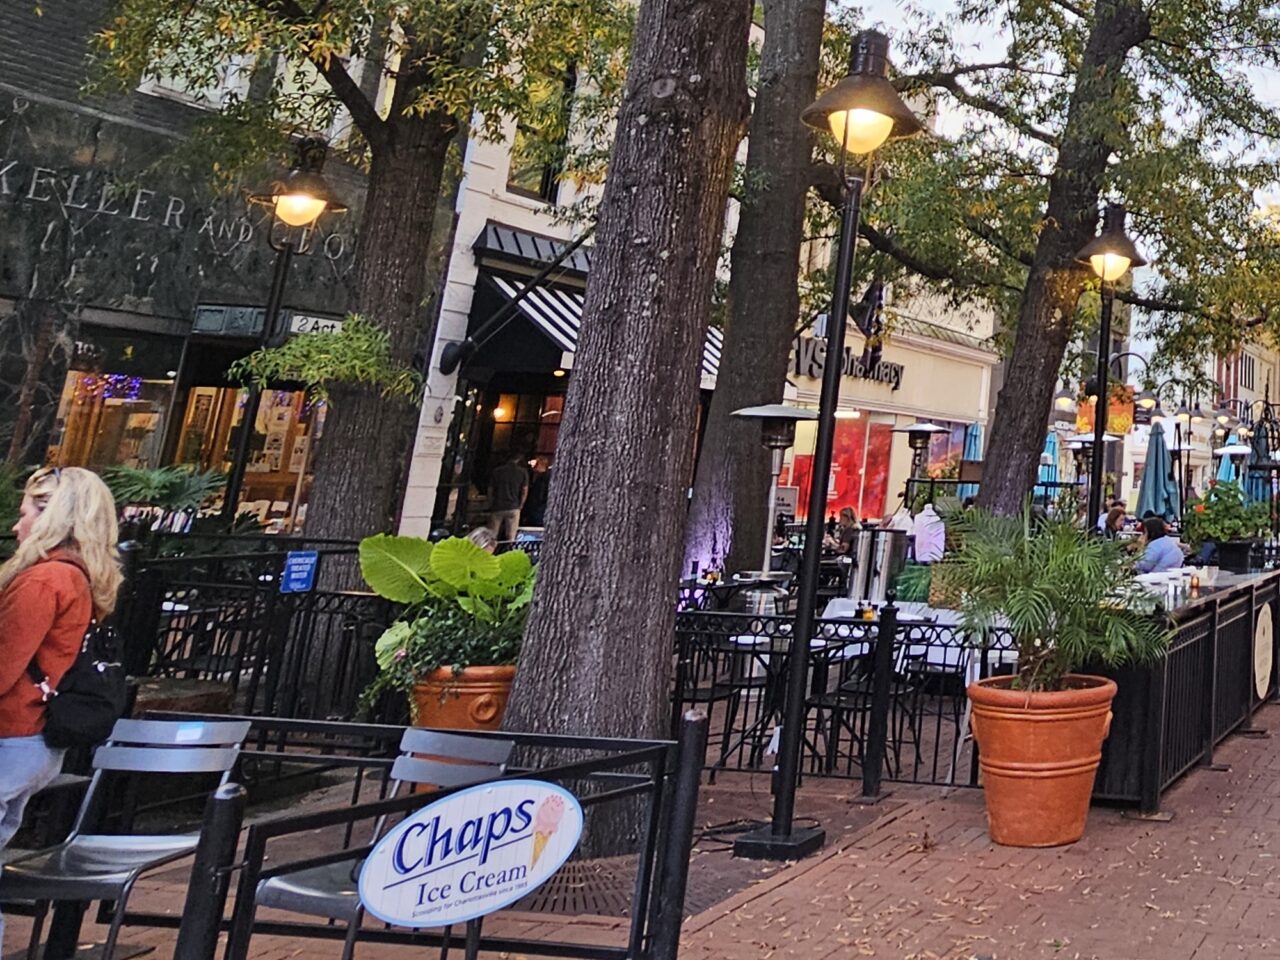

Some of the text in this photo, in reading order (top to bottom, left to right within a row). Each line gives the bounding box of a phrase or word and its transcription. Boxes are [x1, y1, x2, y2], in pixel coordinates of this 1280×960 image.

[199, 215, 253, 242] AND
[392, 799, 535, 875] Chaps
[415, 864, 527, 906] Ice Cream
